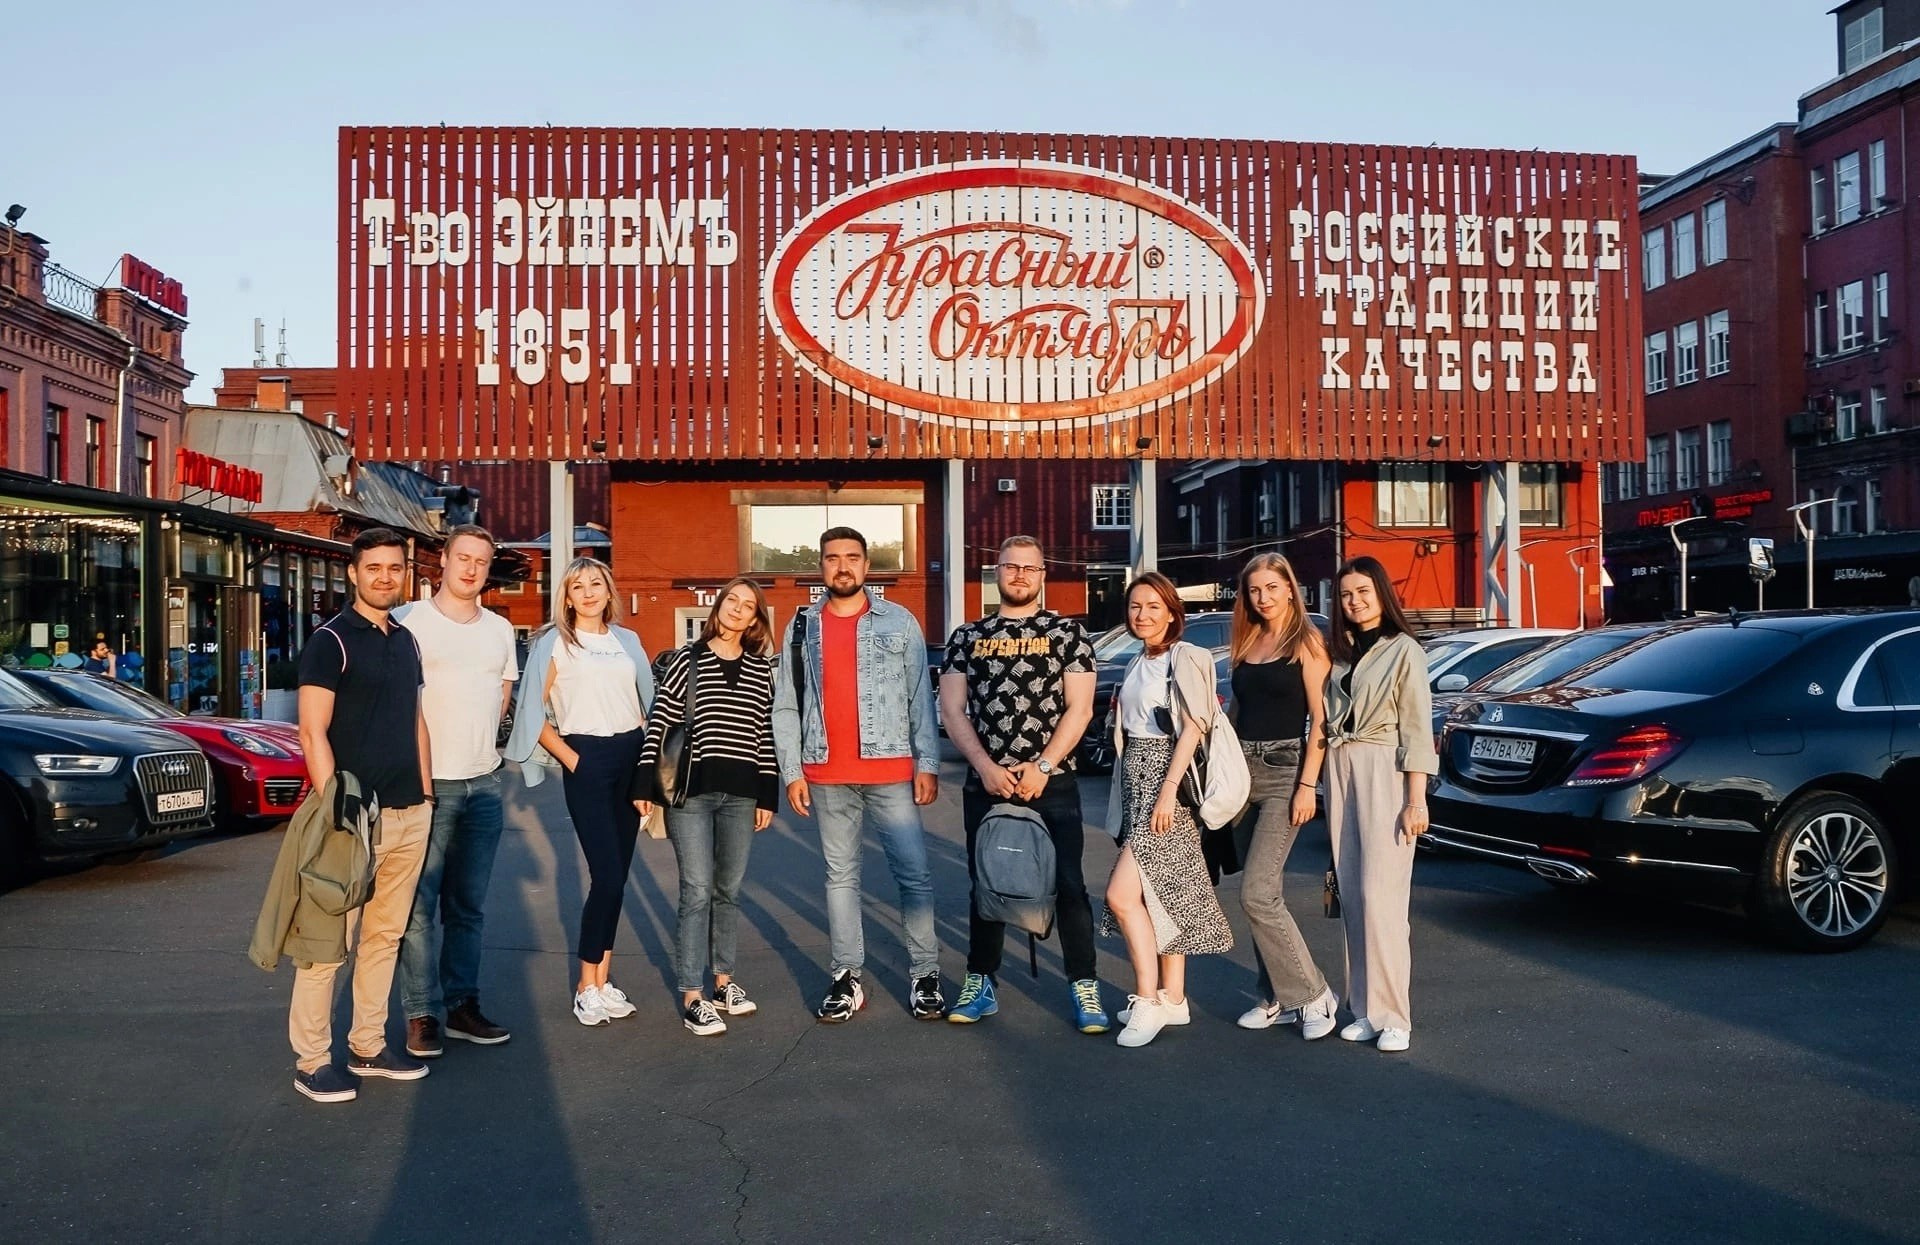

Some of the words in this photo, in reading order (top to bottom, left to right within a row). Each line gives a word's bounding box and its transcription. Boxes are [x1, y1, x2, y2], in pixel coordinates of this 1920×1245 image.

[493, 197, 738, 266] ЭЙНЕМЪ
[1289, 209, 1621, 271] РОССИЙСКИЕ
[835, 220, 1138, 320] Красный
[1317, 273, 1598, 337] ТРАДИЦИИ
[475, 307, 632, 386] 1851
[930, 293, 1196, 393] Октябрь
[1321, 337, 1597, 393] КАЧЕСТВА
[975, 636, 1050, 656] EXPEDITION
